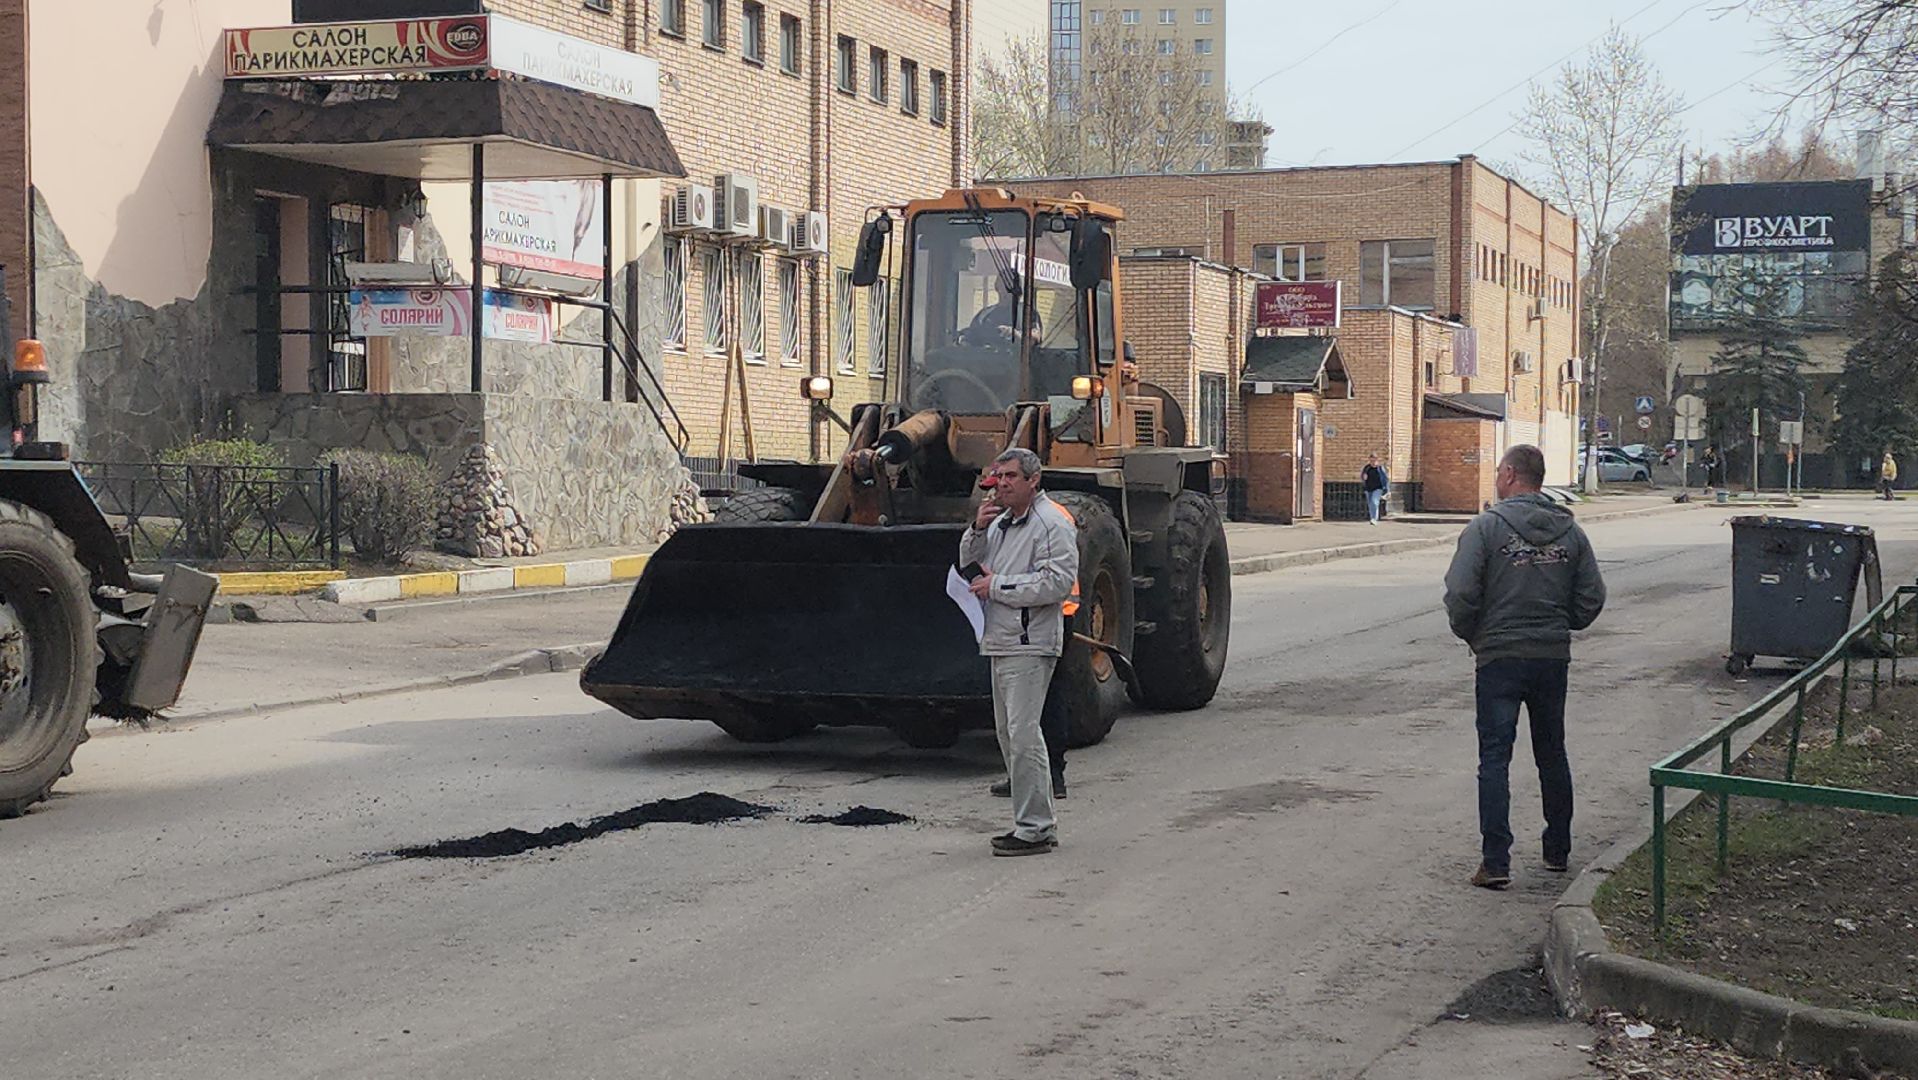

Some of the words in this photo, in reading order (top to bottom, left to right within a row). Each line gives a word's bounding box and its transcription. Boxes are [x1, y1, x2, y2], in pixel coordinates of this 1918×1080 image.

[292, 28, 367, 48] САЛОН
[233, 46, 427, 73] ПАРИКМАХЕРСКАЯ
[557, 41, 600, 69] САЛОН
[498, 210, 530, 229] САЛОН
[1744, 215, 1833, 238] ВУАРТ
[484, 227, 557, 253] АРИКМАХЕРСКАЯ
[380, 304, 444, 325] СОЛЯРИЙ
